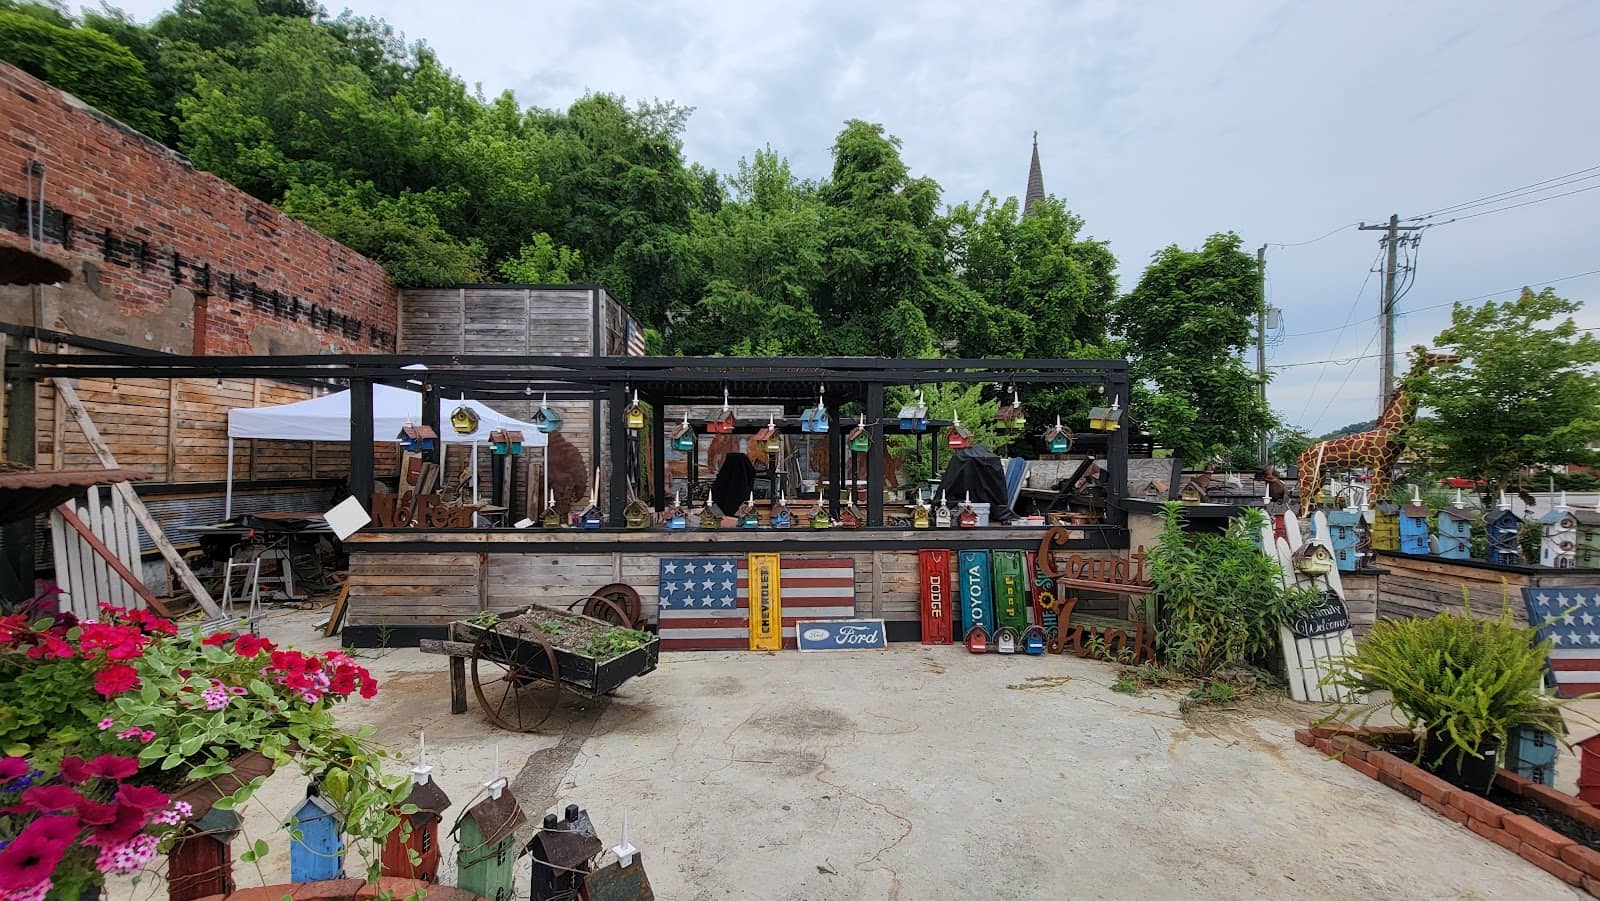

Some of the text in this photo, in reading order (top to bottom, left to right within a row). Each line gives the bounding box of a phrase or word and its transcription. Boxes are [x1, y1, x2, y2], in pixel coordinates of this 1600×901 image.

[761, 569, 770, 634] CHEVROLET
[930, 576, 942, 618] DODGE
[1005, 576, 1015, 617] Jeep
[835, 625, 879, 645] Ford
